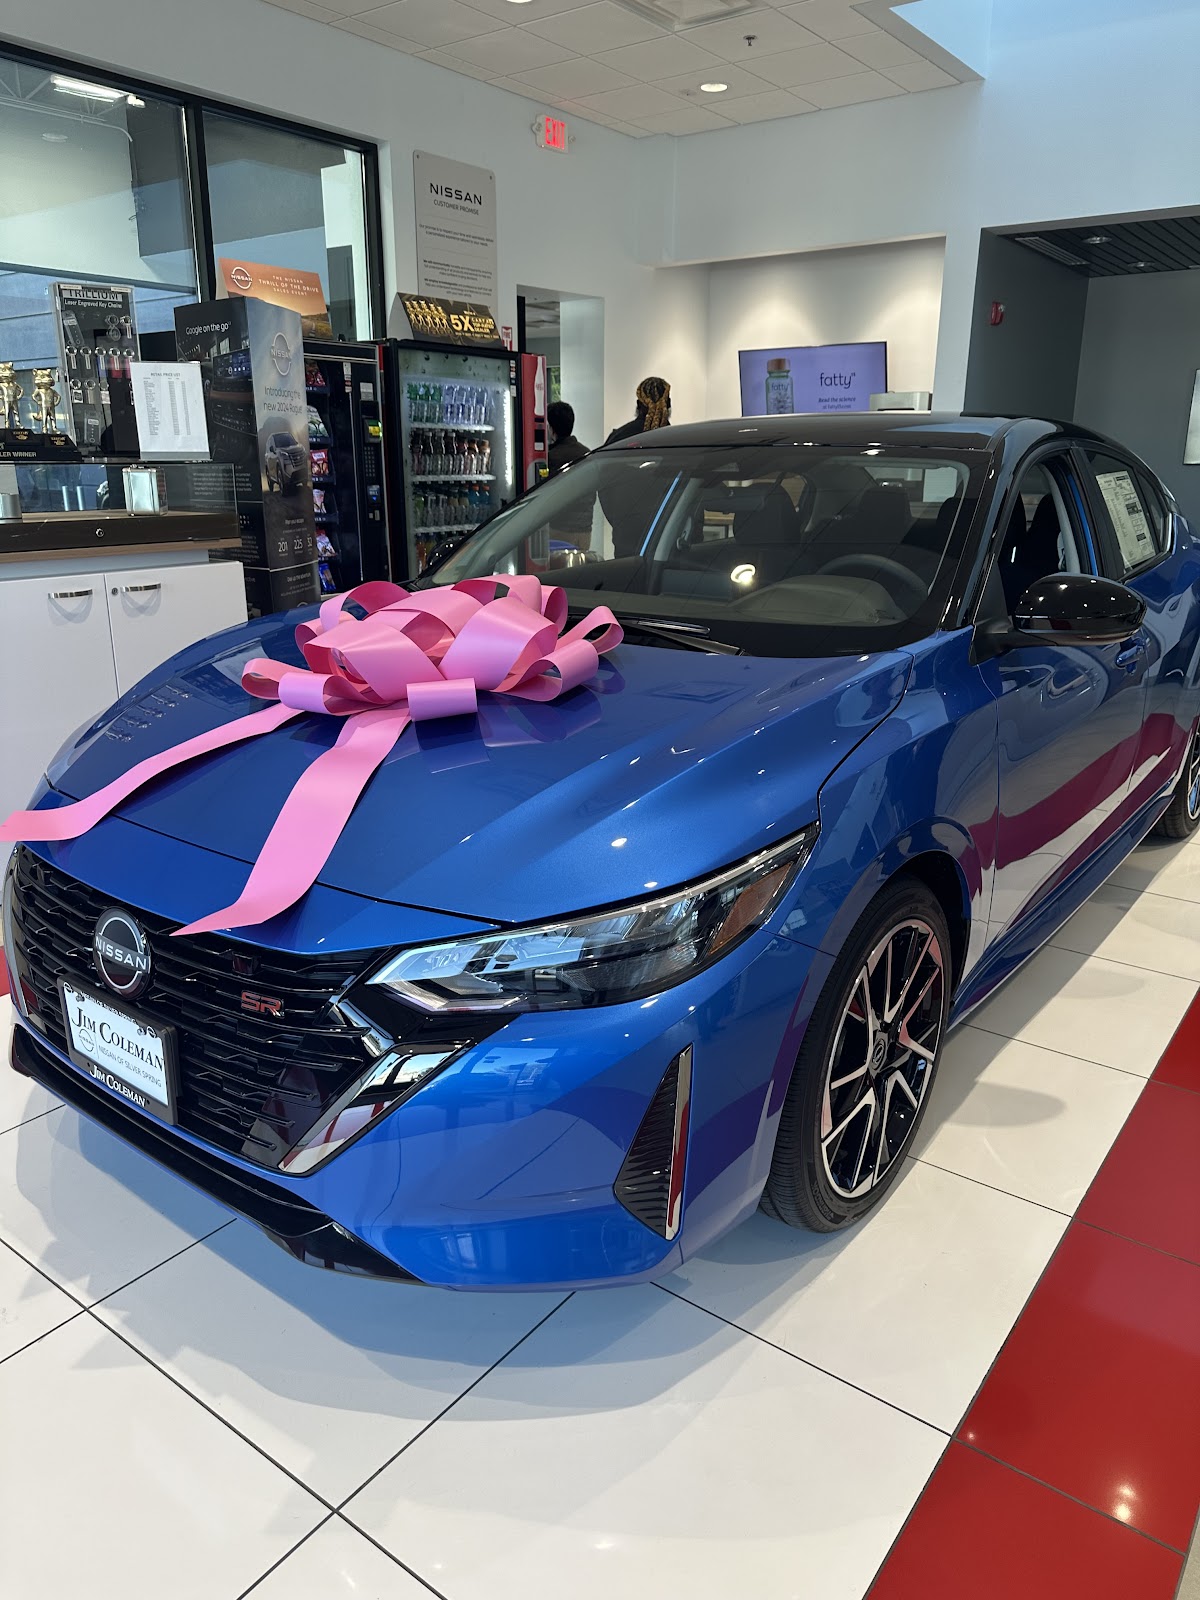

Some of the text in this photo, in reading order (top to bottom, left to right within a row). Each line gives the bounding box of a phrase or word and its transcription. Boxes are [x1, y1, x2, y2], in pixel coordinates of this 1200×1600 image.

[546, 117, 565, 150] EXIT
[430, 182, 482, 206] NISSAN
[434, 199, 479, 216] CUSTOMER PROMISE
[258, 279, 279, 287] THRILL
[78, 300, 98, 308] Engraved
[186, 326, 202, 336] Google
[211, 323, 220, 331] the
[221, 323, 228, 333] go
[450, 314, 474, 332] 5X
[264, 386, 293, 400] Introducing
[264, 402, 276, 411] new
[277, 402, 289, 412] 2024
[278, 541, 288, 552] 201
[294, 539, 303, 550] 225
[96, 936, 147, 970] NISSAN
[241, 991, 281, 1017] SR
[71, 1007, 96, 1033] JIM
[100, 1022, 164, 1072] COLEMAN
[99, 1045, 162, 1087] NISSAN OF SILVER SPRING
[90, 1065, 146, 1107] JIM COLEMAN
